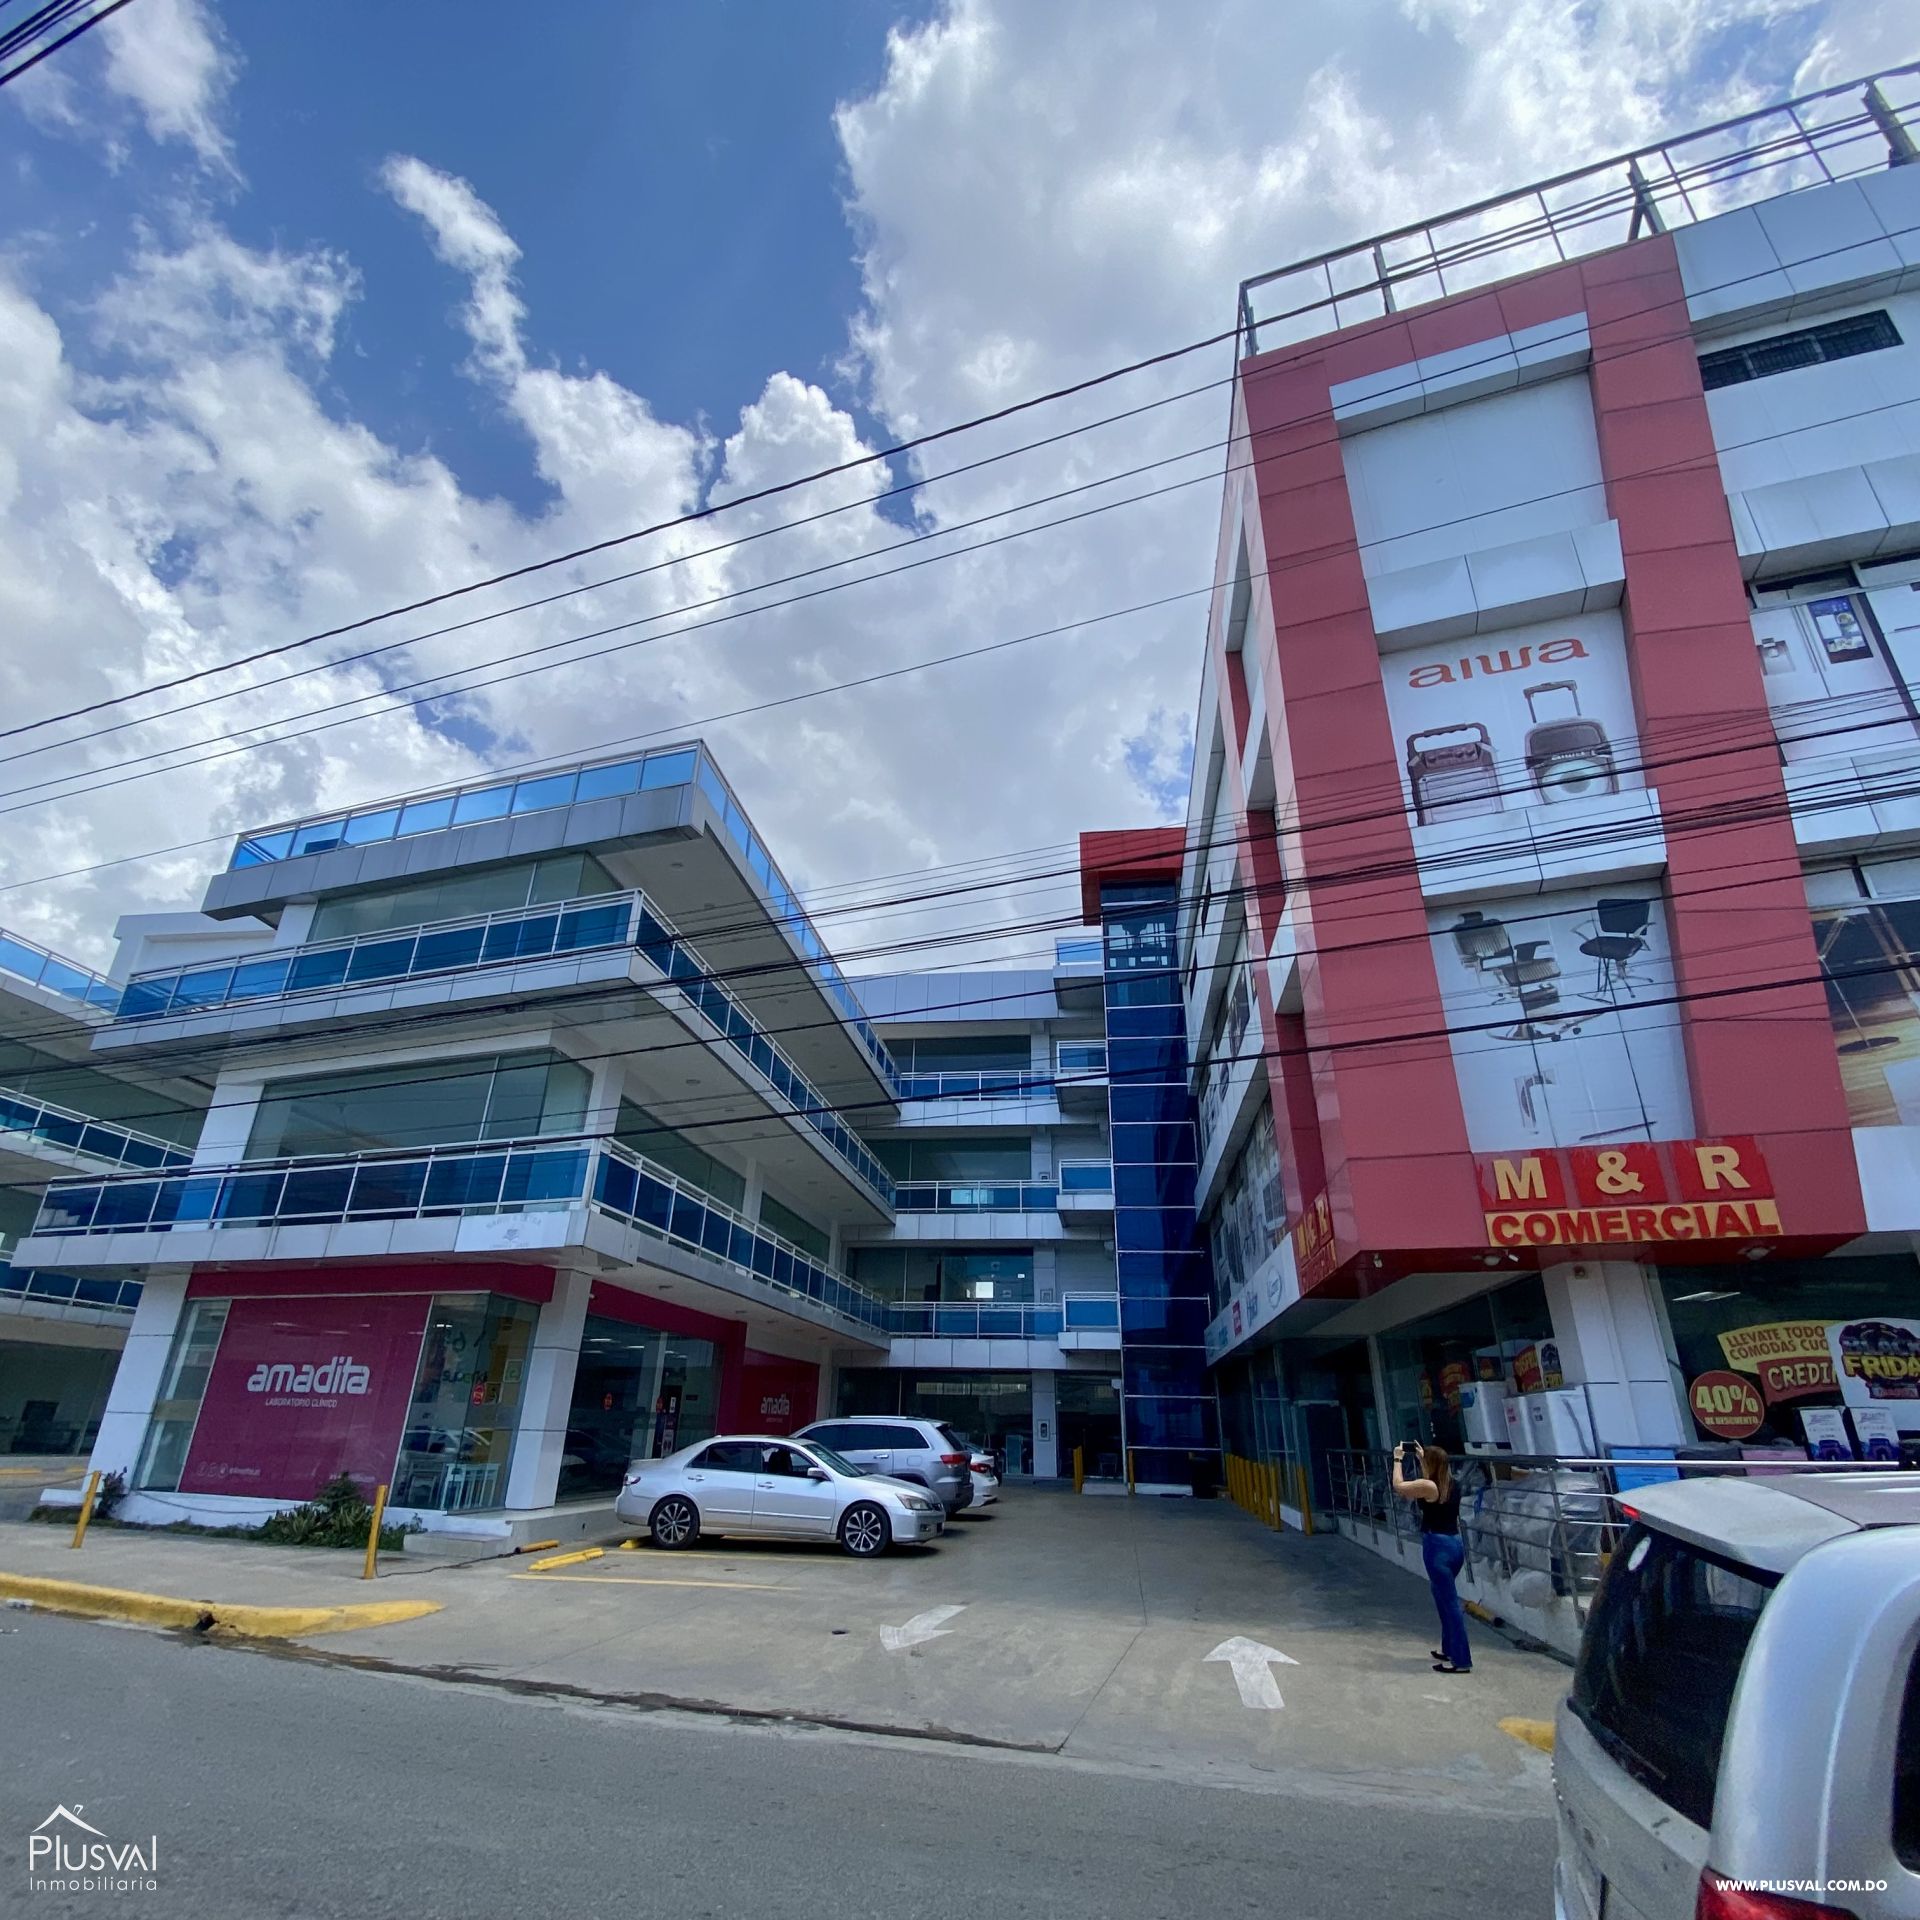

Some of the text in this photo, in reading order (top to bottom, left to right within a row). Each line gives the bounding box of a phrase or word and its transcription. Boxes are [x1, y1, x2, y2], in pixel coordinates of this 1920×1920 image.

[1492, 1145, 1751, 1200] M & R
[1492, 1202, 1781, 1247] COMERCIAL
[1726, 1328, 1780, 1348] LLEVATE
[1729, 1341, 1797, 1360] COMODAS
[247, 1356, 370, 1395] amadita
[265, 1398, 310, 1407] LABORATORIO
[1696, 1385, 1759, 1414] 40%
